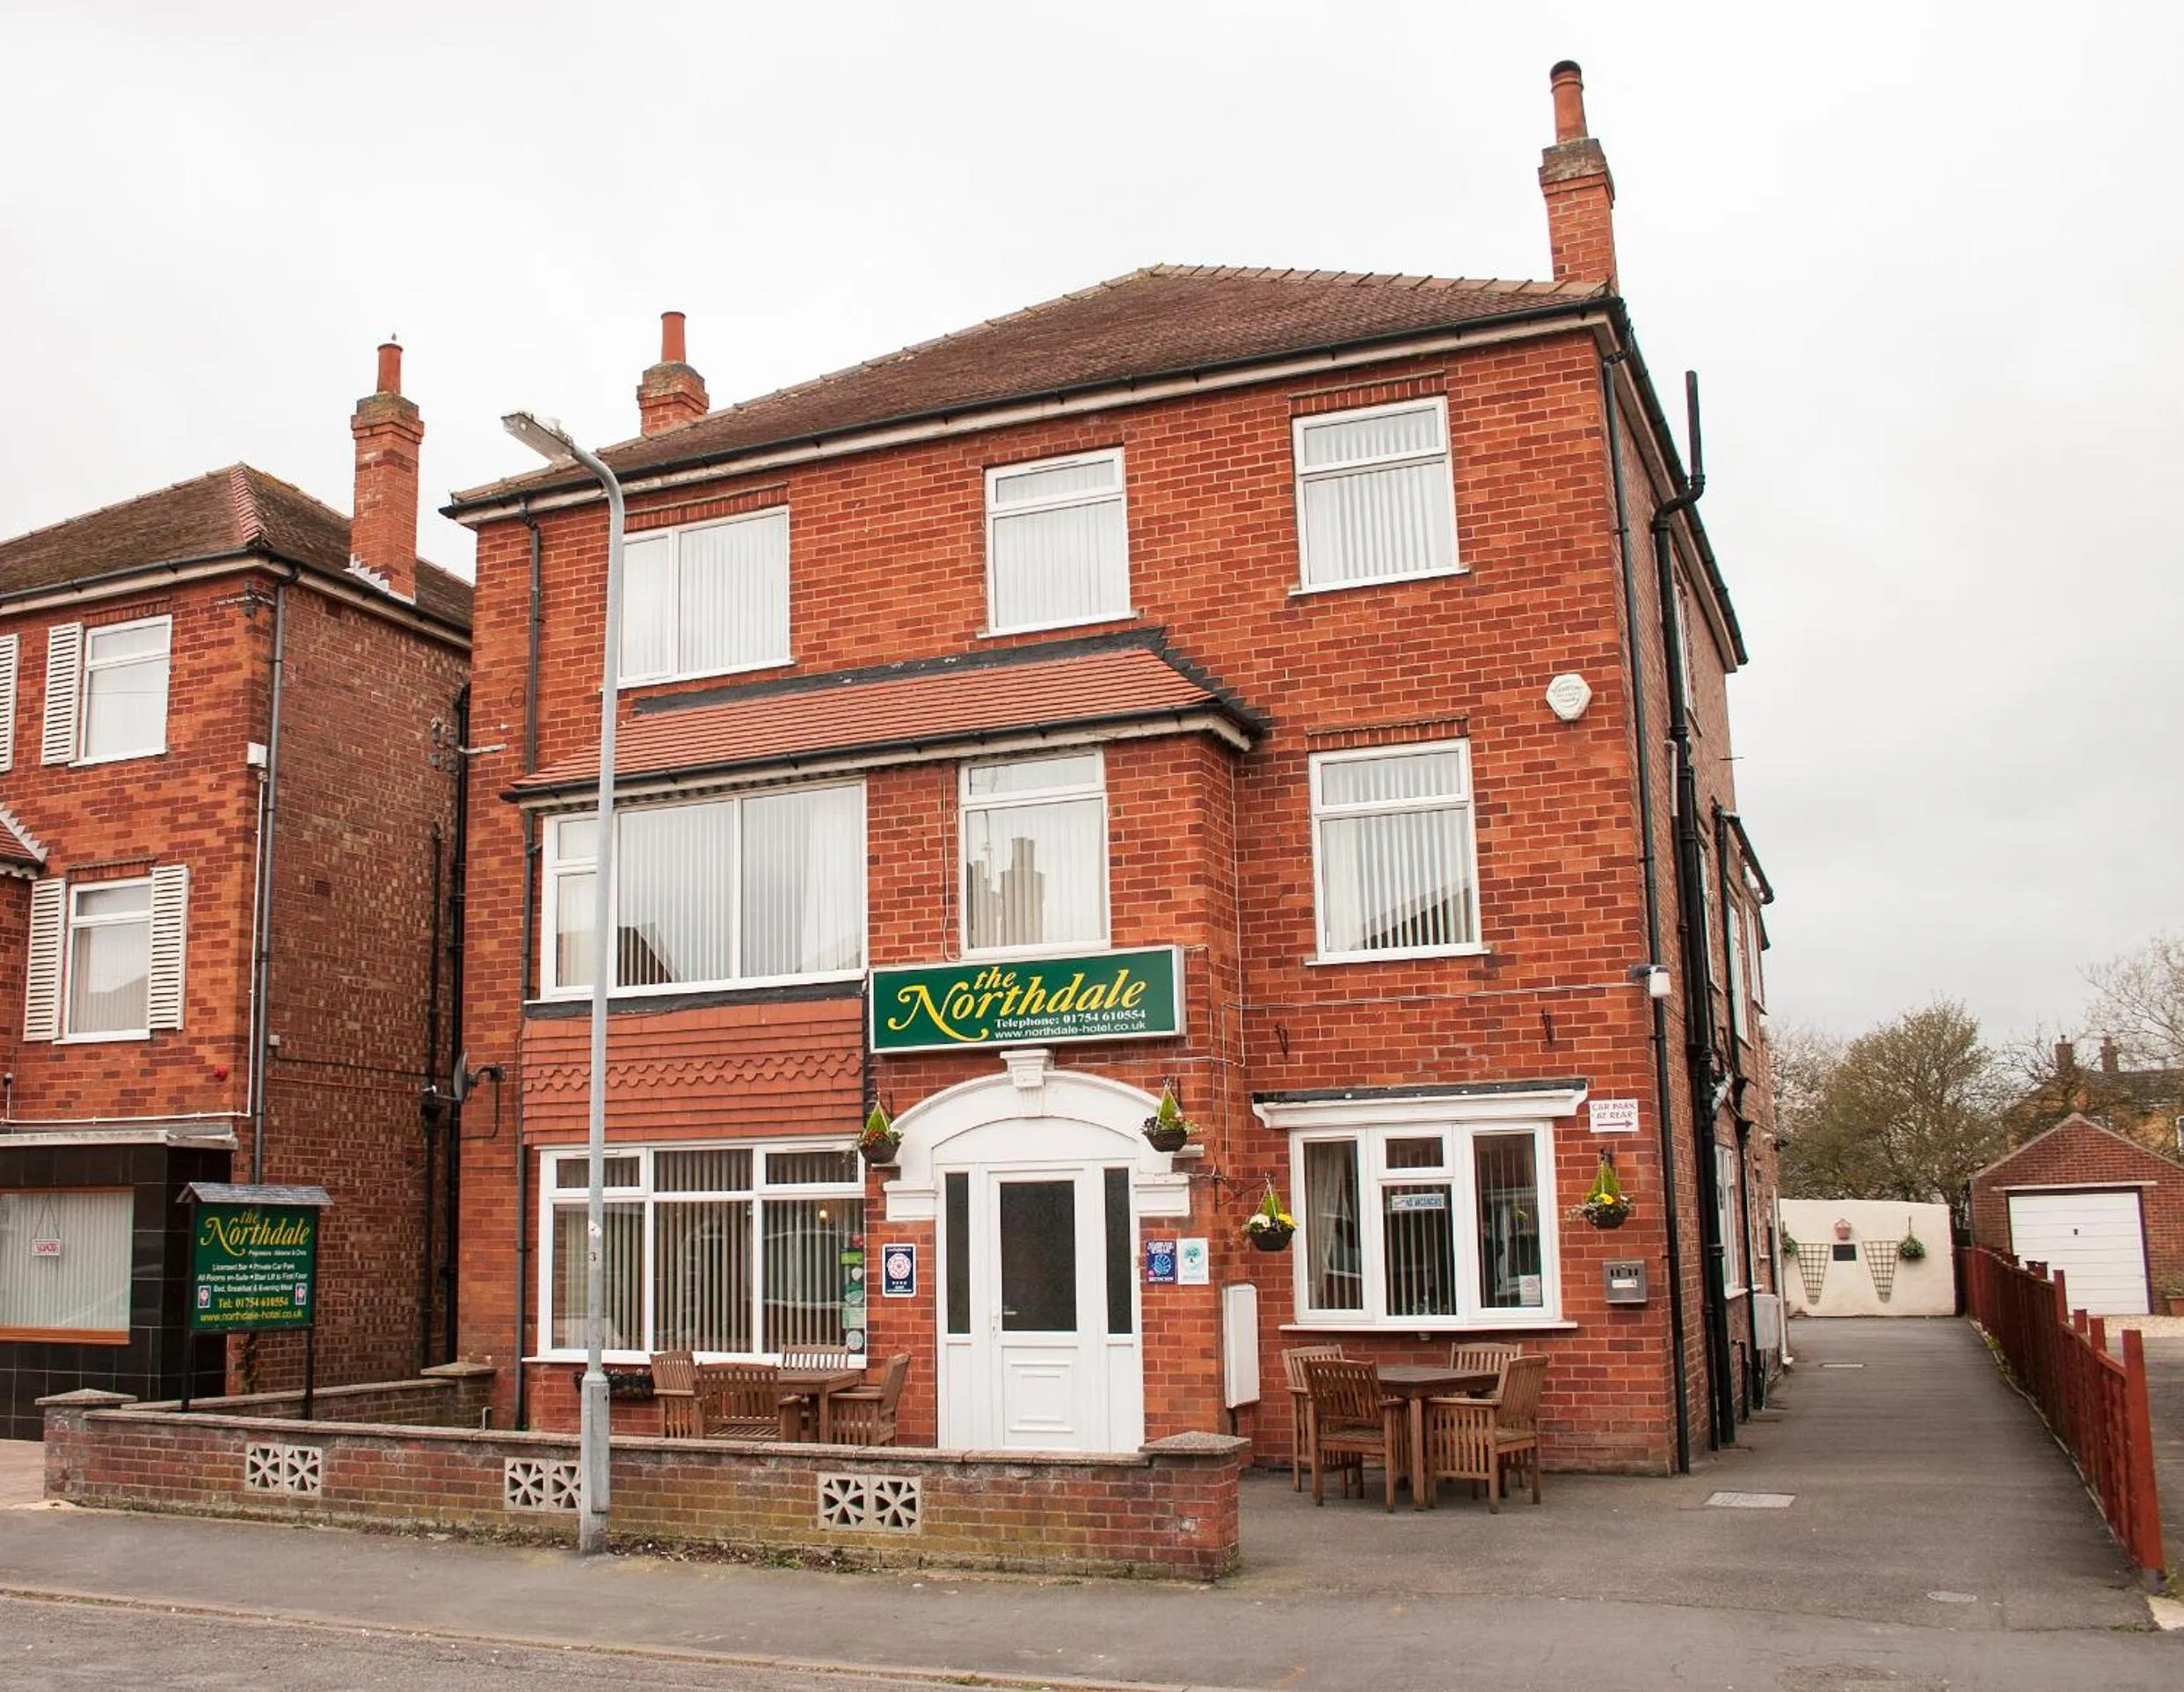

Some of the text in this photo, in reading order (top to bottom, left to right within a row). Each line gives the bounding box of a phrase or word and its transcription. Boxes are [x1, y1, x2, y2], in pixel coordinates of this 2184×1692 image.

[973, 966, 1017, 989] the
[887, 969, 1147, 1042] Northdale
[994, 1021, 1146, 1039] www.northdale-hotel.co.uk
[995, 1010, 1146, 1029] Telephone: 01754 610554
[240, 1209, 258, 1223] the
[200, 1217, 309, 1256] Northdale
